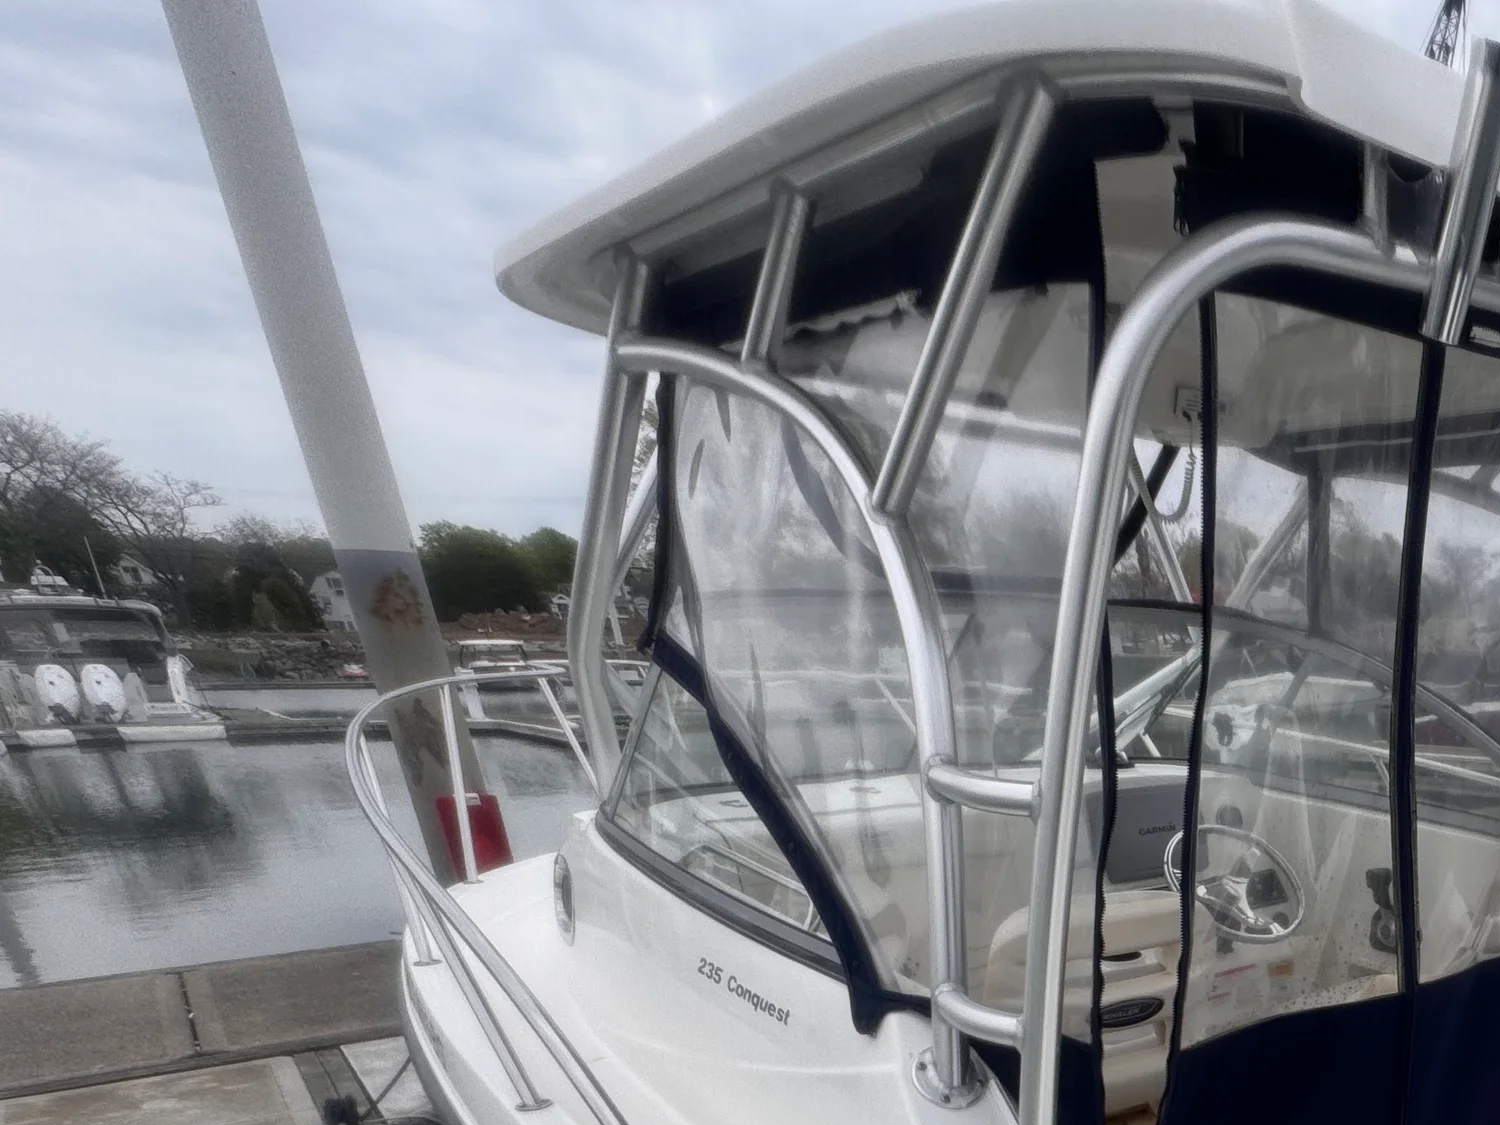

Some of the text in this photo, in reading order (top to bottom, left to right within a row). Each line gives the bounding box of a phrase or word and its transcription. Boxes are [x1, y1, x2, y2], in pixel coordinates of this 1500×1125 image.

[1138, 823, 1177, 836] GARMIN
[697, 957, 790, 1026] 235 Conquest
